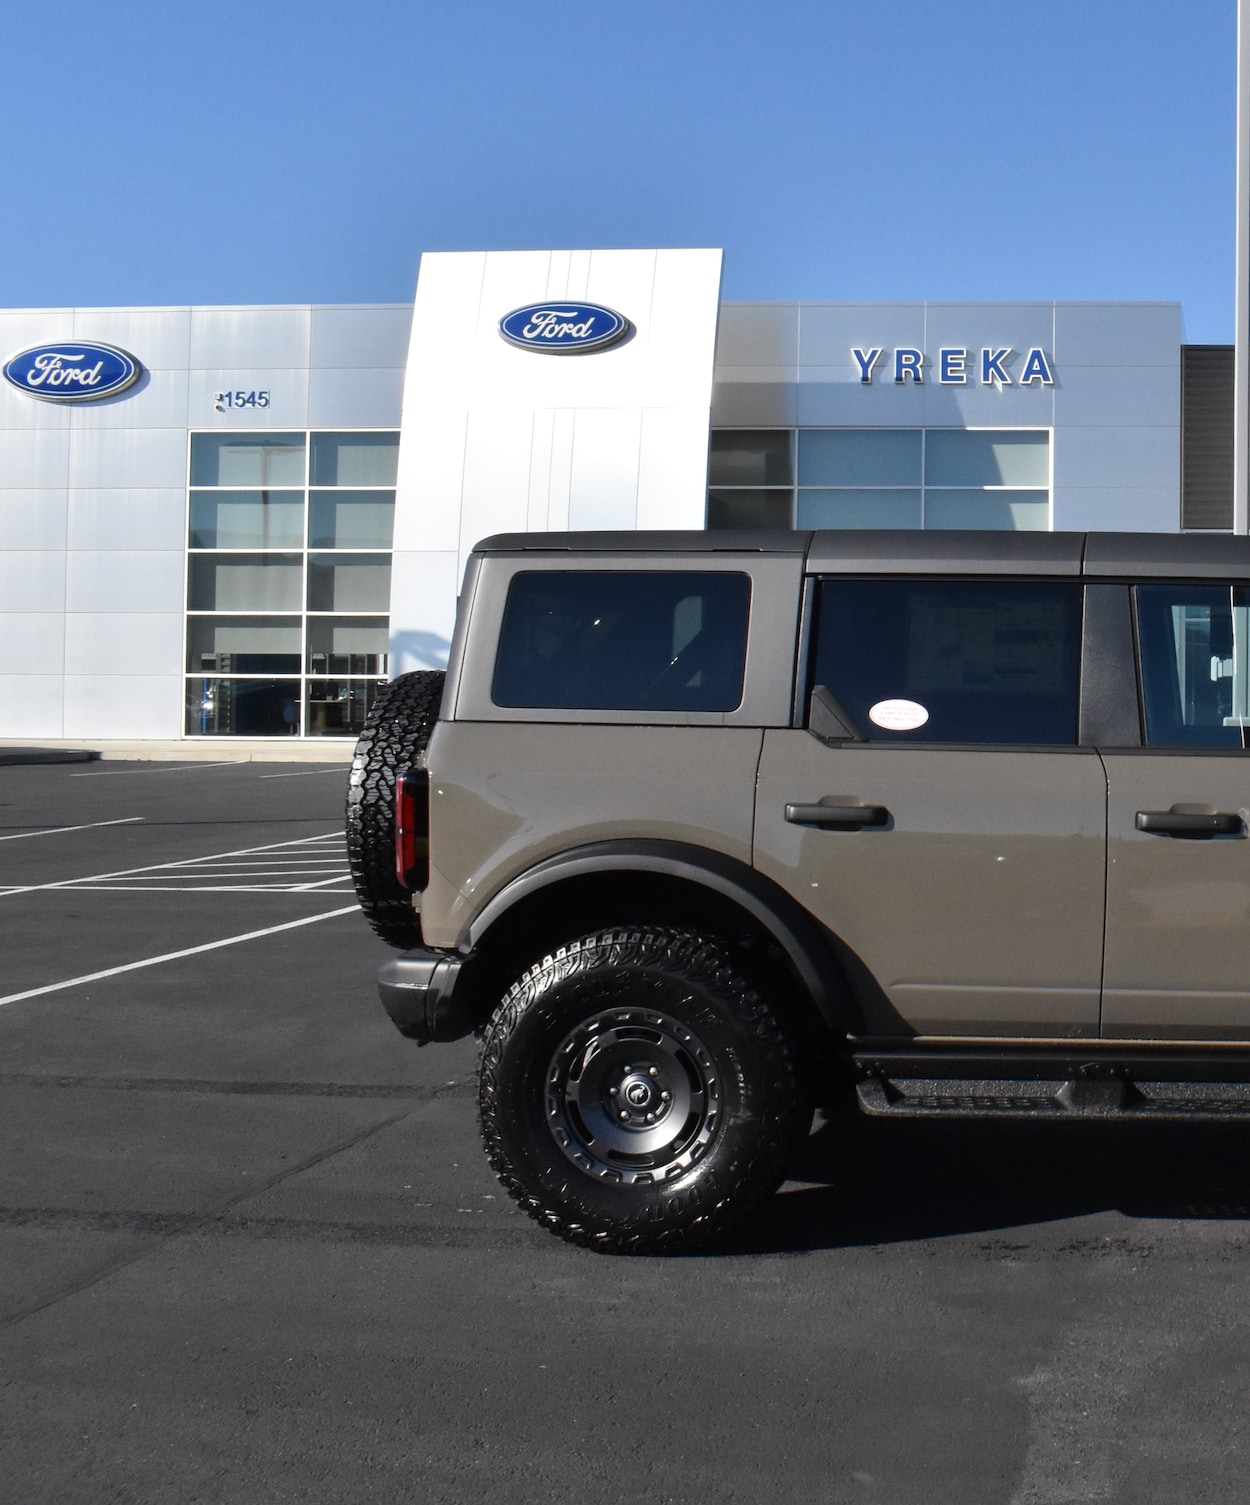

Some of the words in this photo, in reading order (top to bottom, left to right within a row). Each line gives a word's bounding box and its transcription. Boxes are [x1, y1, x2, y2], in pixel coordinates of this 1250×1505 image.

[522, 310, 596, 339] Ford
[26, 352, 105, 387] Ford
[850, 347, 1054, 385] YREKA
[224, 390, 270, 408] 1545
